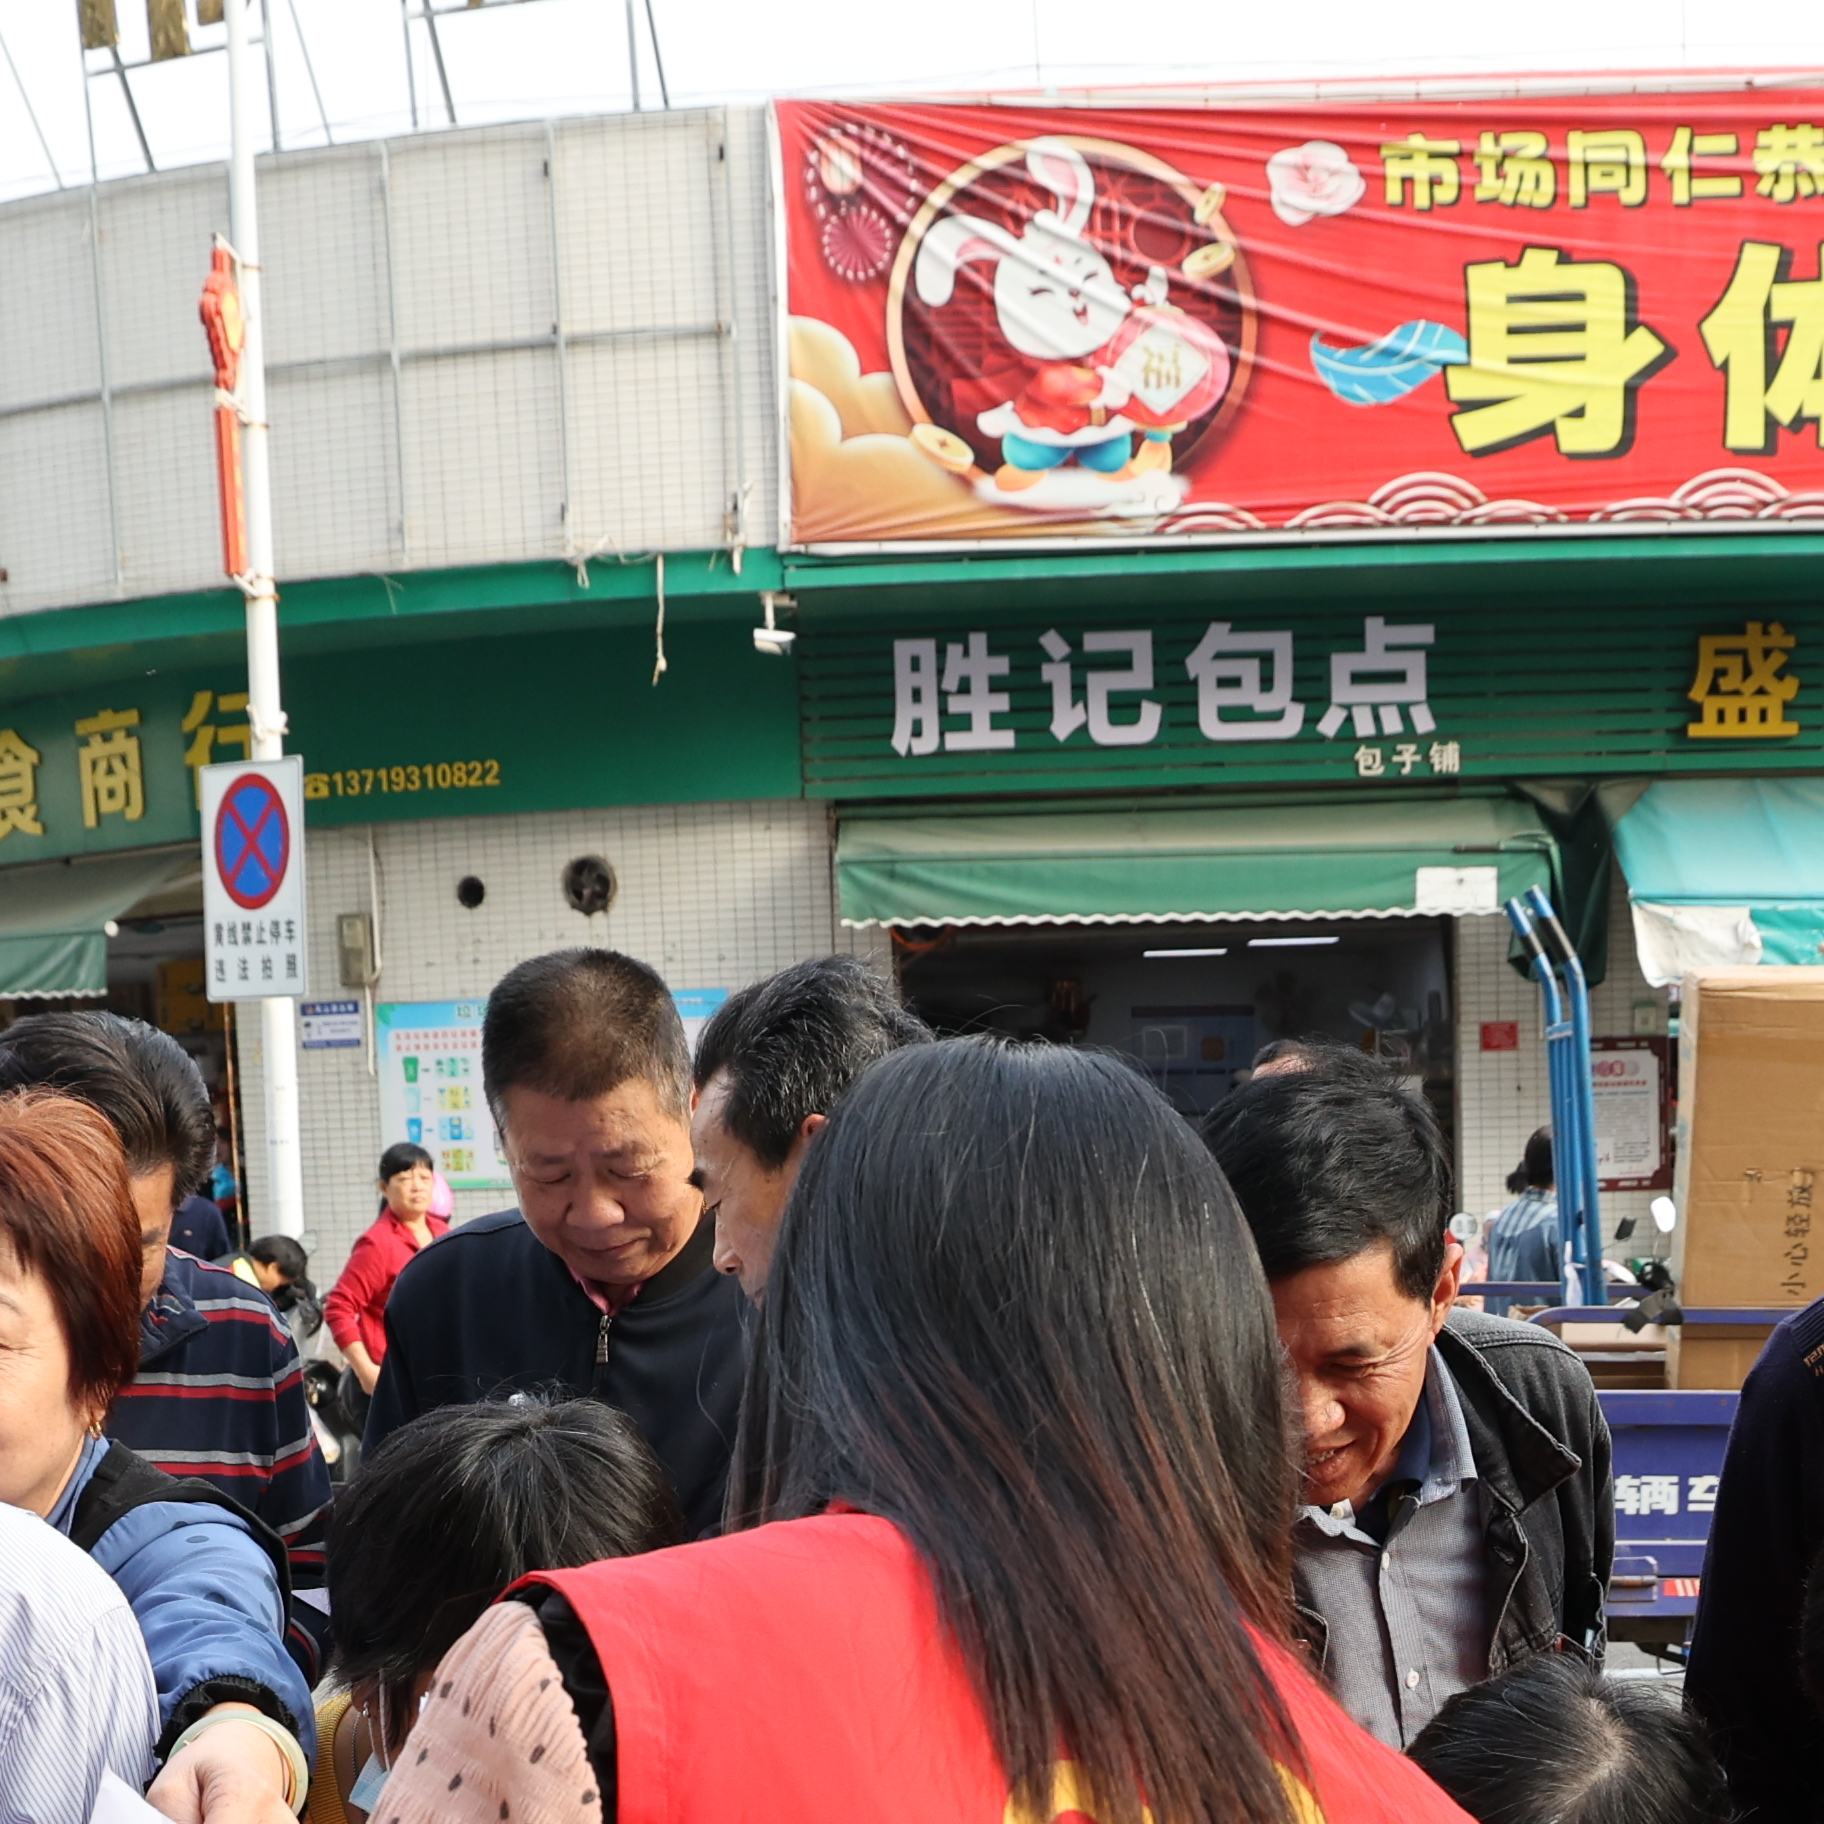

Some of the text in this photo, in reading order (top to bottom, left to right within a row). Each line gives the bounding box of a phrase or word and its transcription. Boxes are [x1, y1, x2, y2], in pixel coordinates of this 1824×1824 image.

[891, 616, 1437, 757] 胜记包点
[331, 759, 501, 796] 13719310822
[1354, 741, 1461, 776] 包子铺
[1781, 1182, 1813, 1297] 小心轻放
